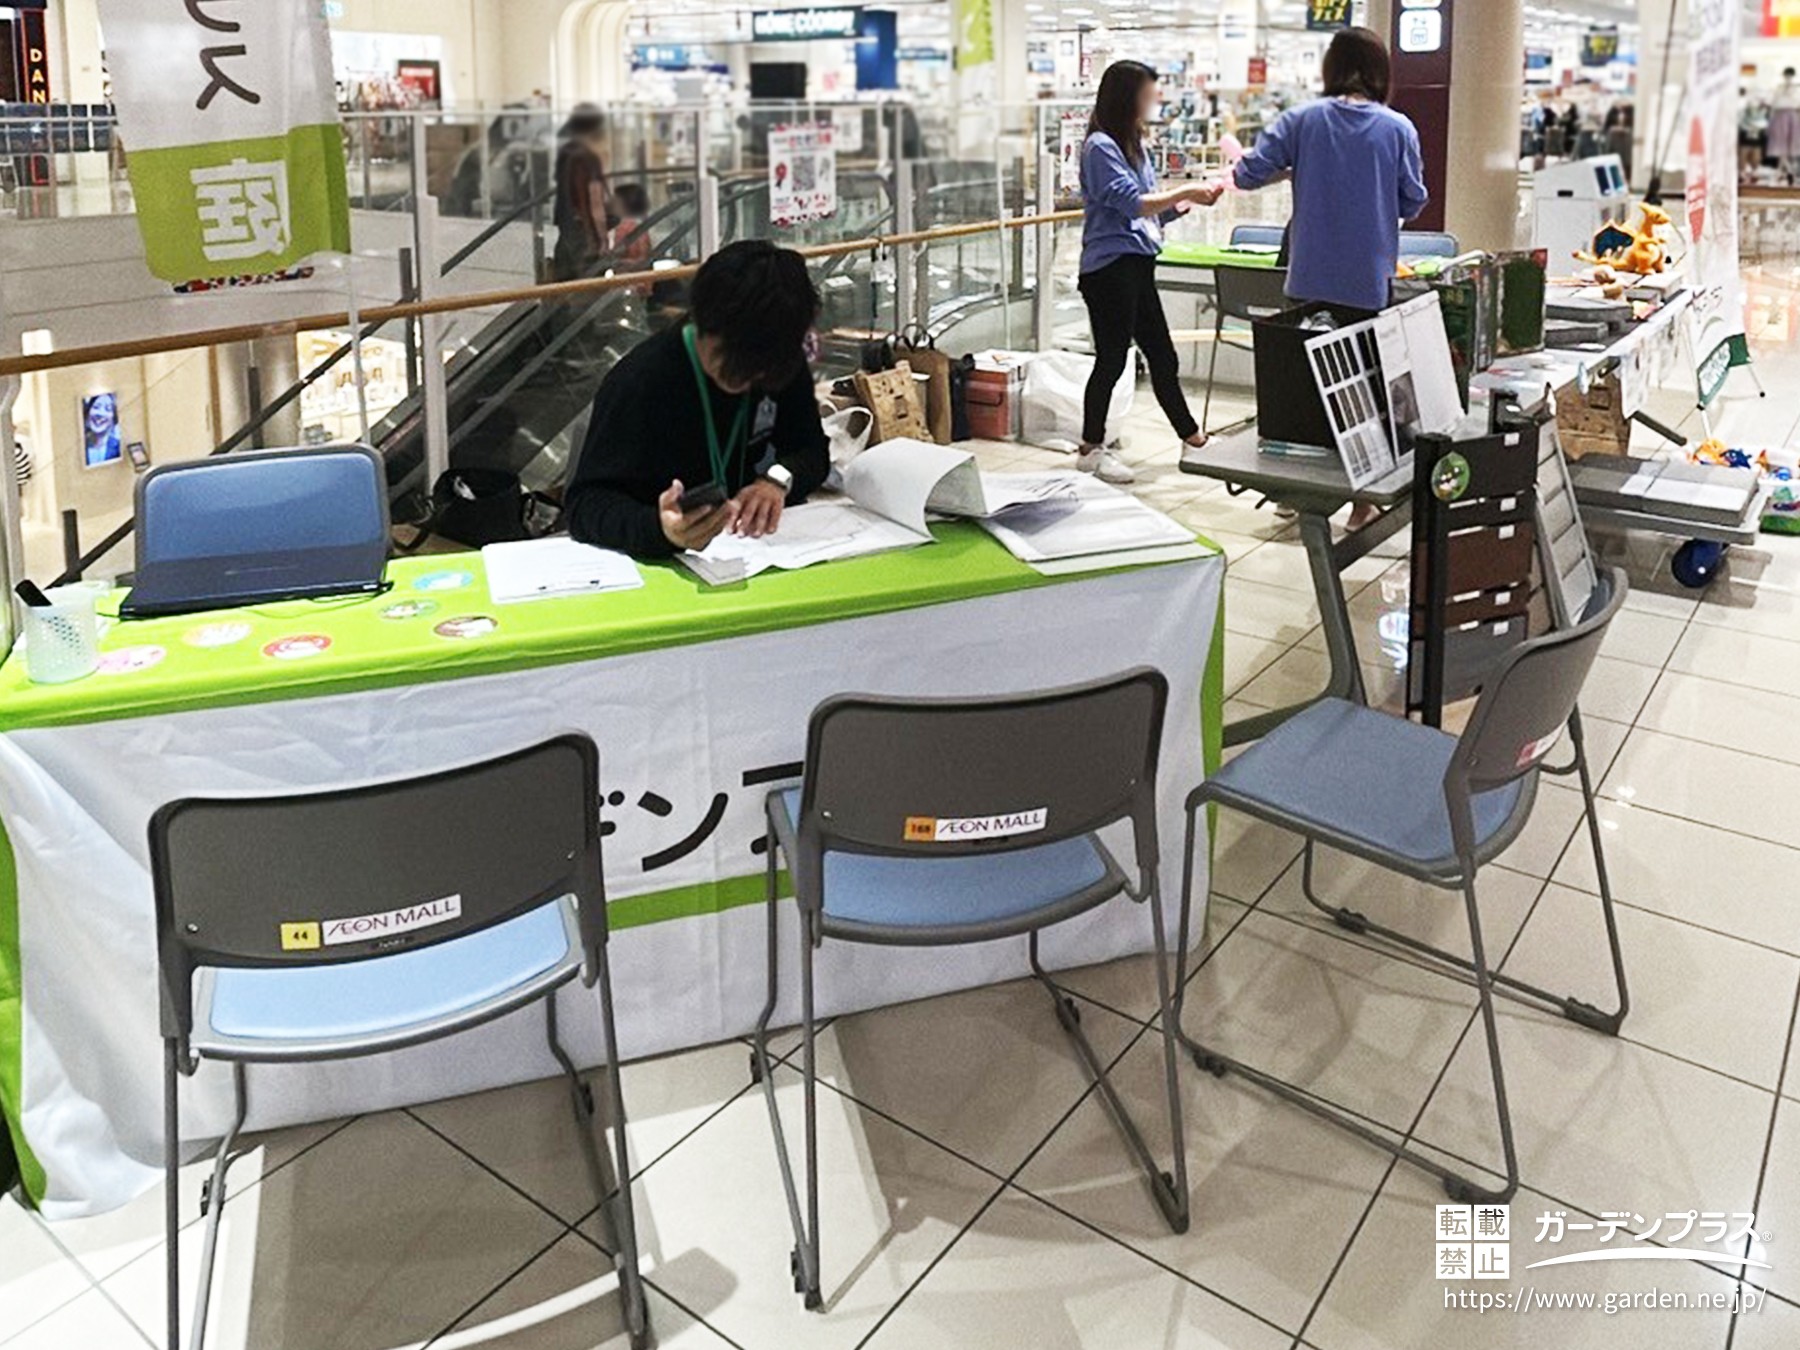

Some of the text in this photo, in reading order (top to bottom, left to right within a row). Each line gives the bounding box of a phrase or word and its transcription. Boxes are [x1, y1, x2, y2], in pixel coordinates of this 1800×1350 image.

[993, 812, 1041, 830] MALL
[292, 931, 308, 940] 44
[394, 900, 456, 926] MALL
